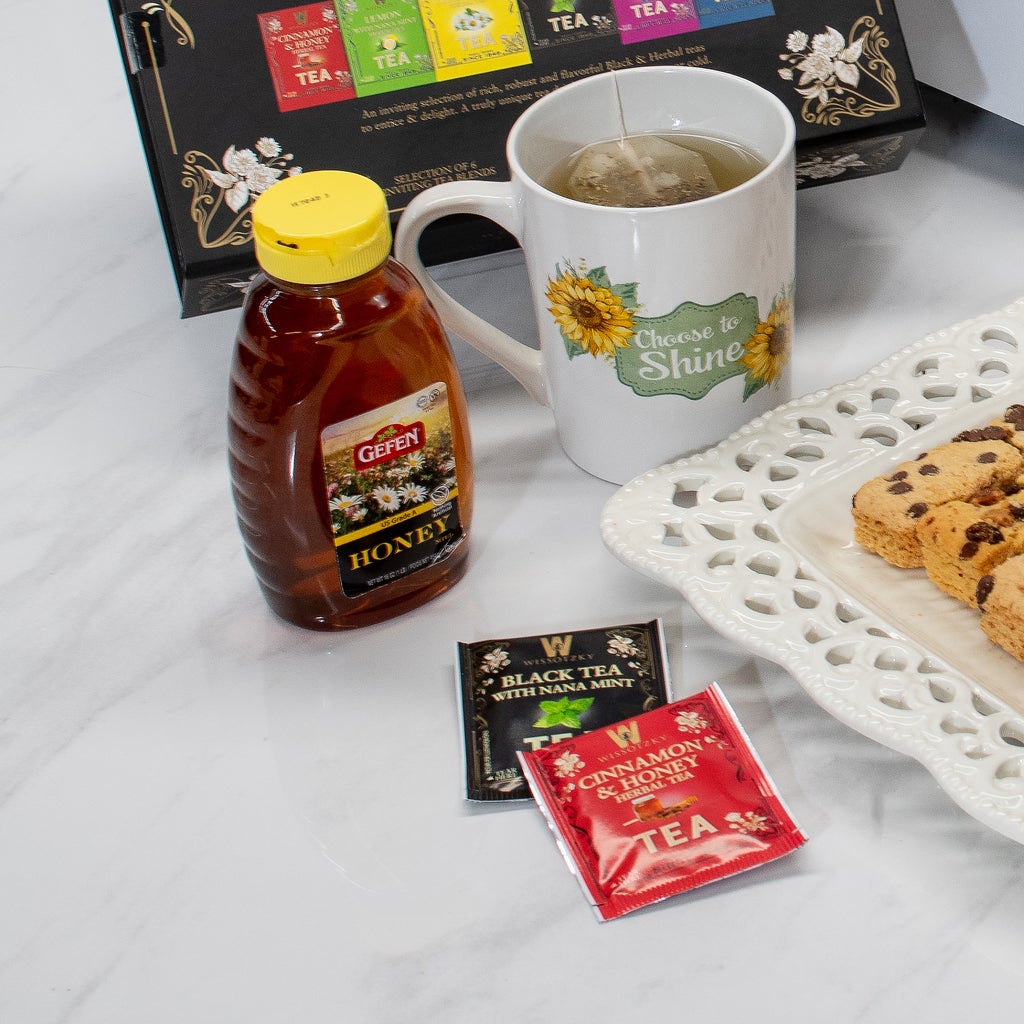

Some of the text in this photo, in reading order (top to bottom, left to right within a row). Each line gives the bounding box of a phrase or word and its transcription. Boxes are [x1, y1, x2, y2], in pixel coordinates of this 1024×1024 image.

[364, 10, 401, 23] LEMON
[630, 1, 668, 19] TEA
[547, 13, 589, 32] TEA
[277, 27, 333, 43] CINNAMON
[284, 36, 331, 51] & HONEY
[456, 32, 496, 50] TEA
[371, 51, 412, 70] TEA
[295, 68, 333, 86] TEA
[362, 108, 377, 119] An
[379, 101, 419, 118] inviting
[420, 92, 464, 107] selection
[466, 88, 478, 98] of
[479, 84, 503, 95] rich,
[505, 78, 537, 90] robust
[540, 71, 559, 83] and
[606, 57, 633, 71] Black
[635, 55, 646, 64] &
[648, 46, 683, 62] Herbal
[685, 45, 705, 55] teas
[360, 123, 373, 133] to
[374, 118, 405, 130] entice
[406, 114, 417, 123] &
[420, 107, 458, 123] delight.
[460, 103, 470, 113] A
[471, 98, 496, 110] truly
[498, 93, 532, 105] unique
[394, 160, 478, 185] SELECTION OF 6
[456, 166, 498, 181] BLENDS
[635, 315, 743, 349] Choose to
[639, 341, 744, 381] Shine
[358, 428, 419, 464] GEFEN
[381, 519, 391, 528] US
[391, 513, 411, 525] Grade
[350, 515, 450, 570] HONEY
[540, 635, 573, 657] W
[523, 653, 594, 666] WISSOTZKY
[501, 664, 623, 688] BLACK TEA
[491, 678, 635, 702] WITH NANA MINT
[605, 721, 641, 748] W
[597, 734, 668, 763] WISSOTZKY
[578, 740, 704, 790] CINNAMON
[597, 754, 699, 800] & HONEY
[616, 771, 695, 804] HERBAL TEA
[632, 814, 719, 853] TEA
